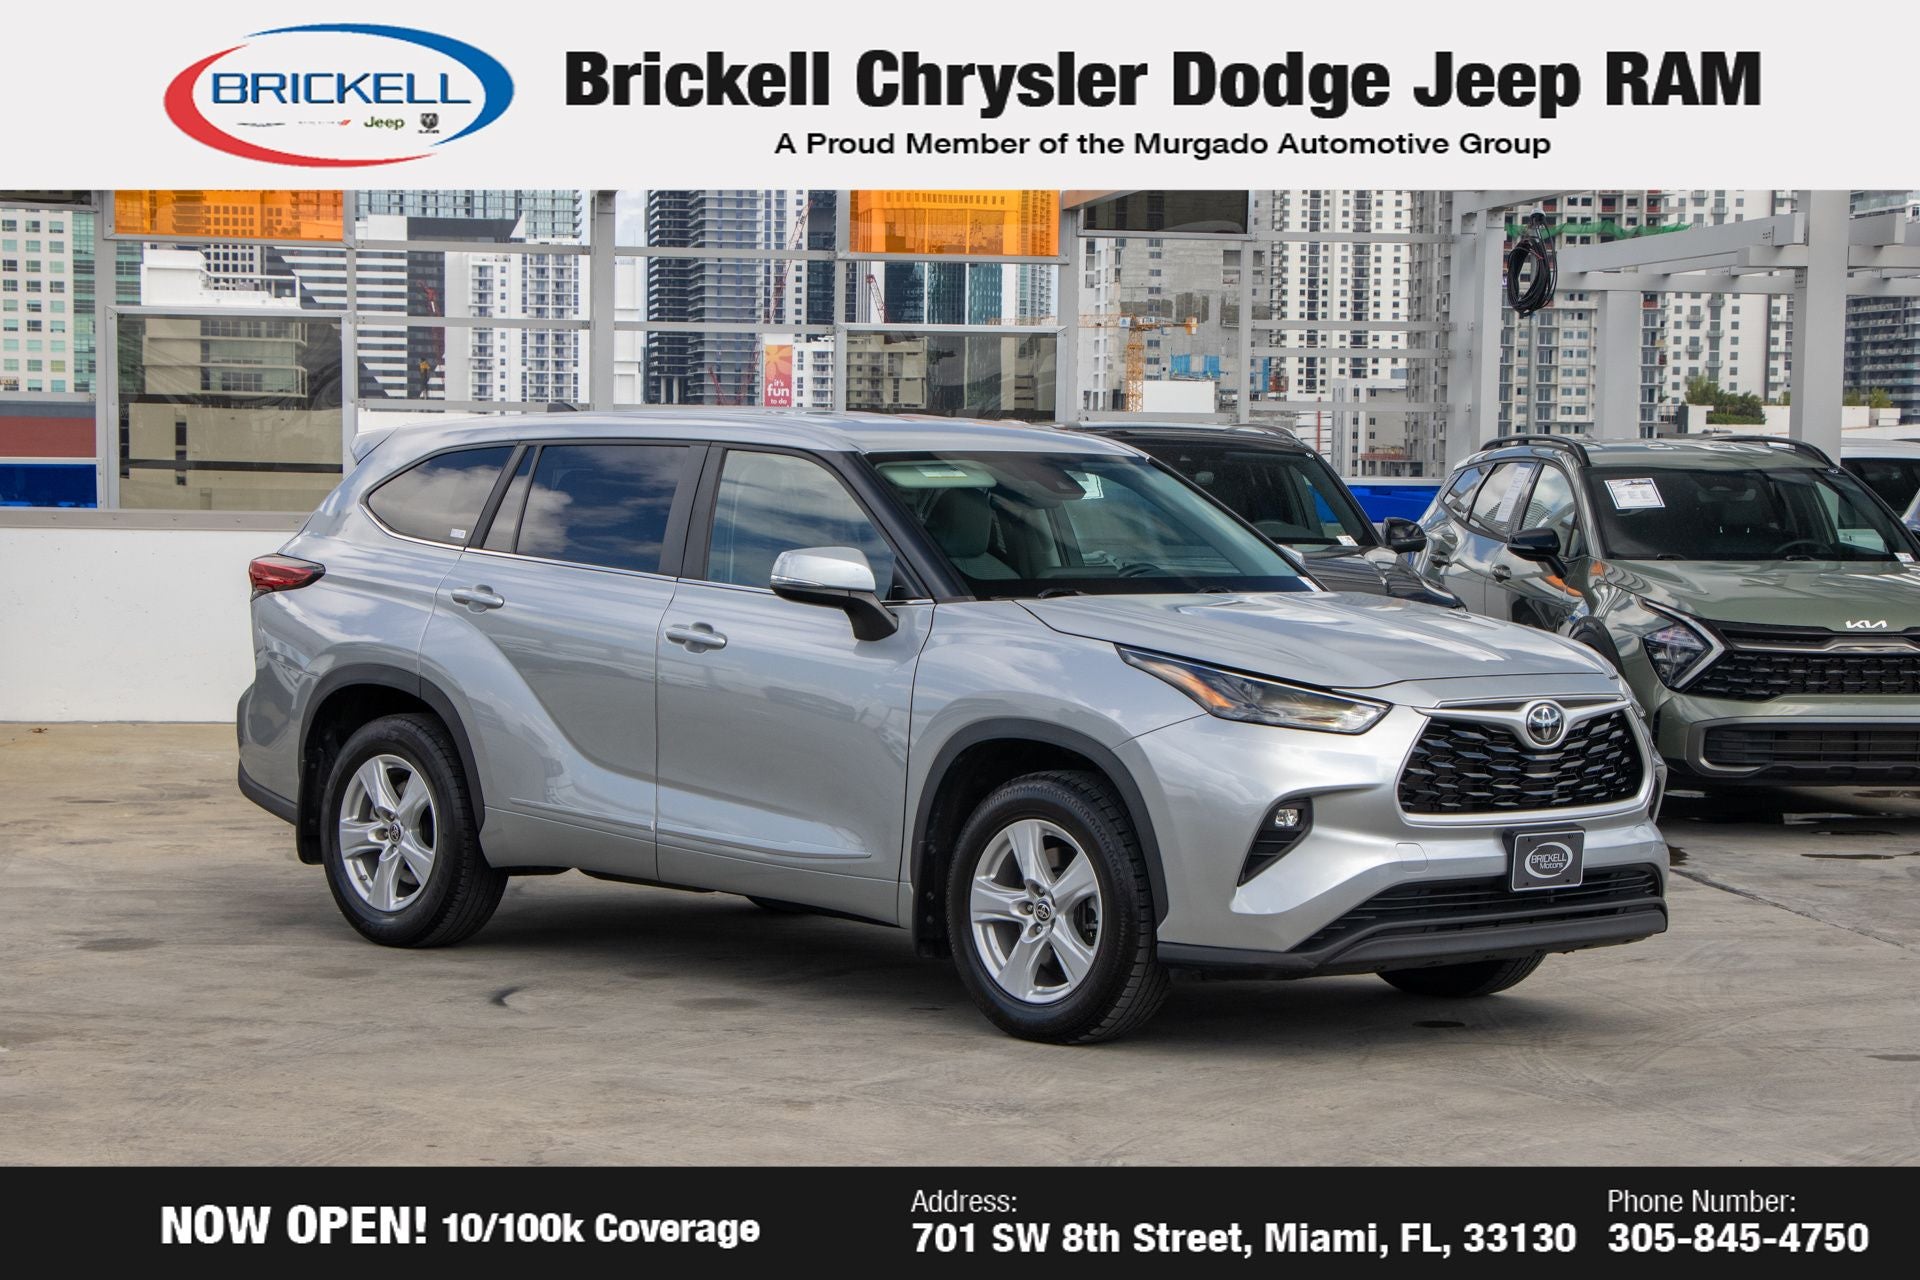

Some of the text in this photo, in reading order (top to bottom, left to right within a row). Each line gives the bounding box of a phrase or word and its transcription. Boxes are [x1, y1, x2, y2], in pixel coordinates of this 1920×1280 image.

[773, 379, 784, 387] it's
[767, 383, 790, 397] fun
[1531, 853, 1567, 864] BRICKELL
